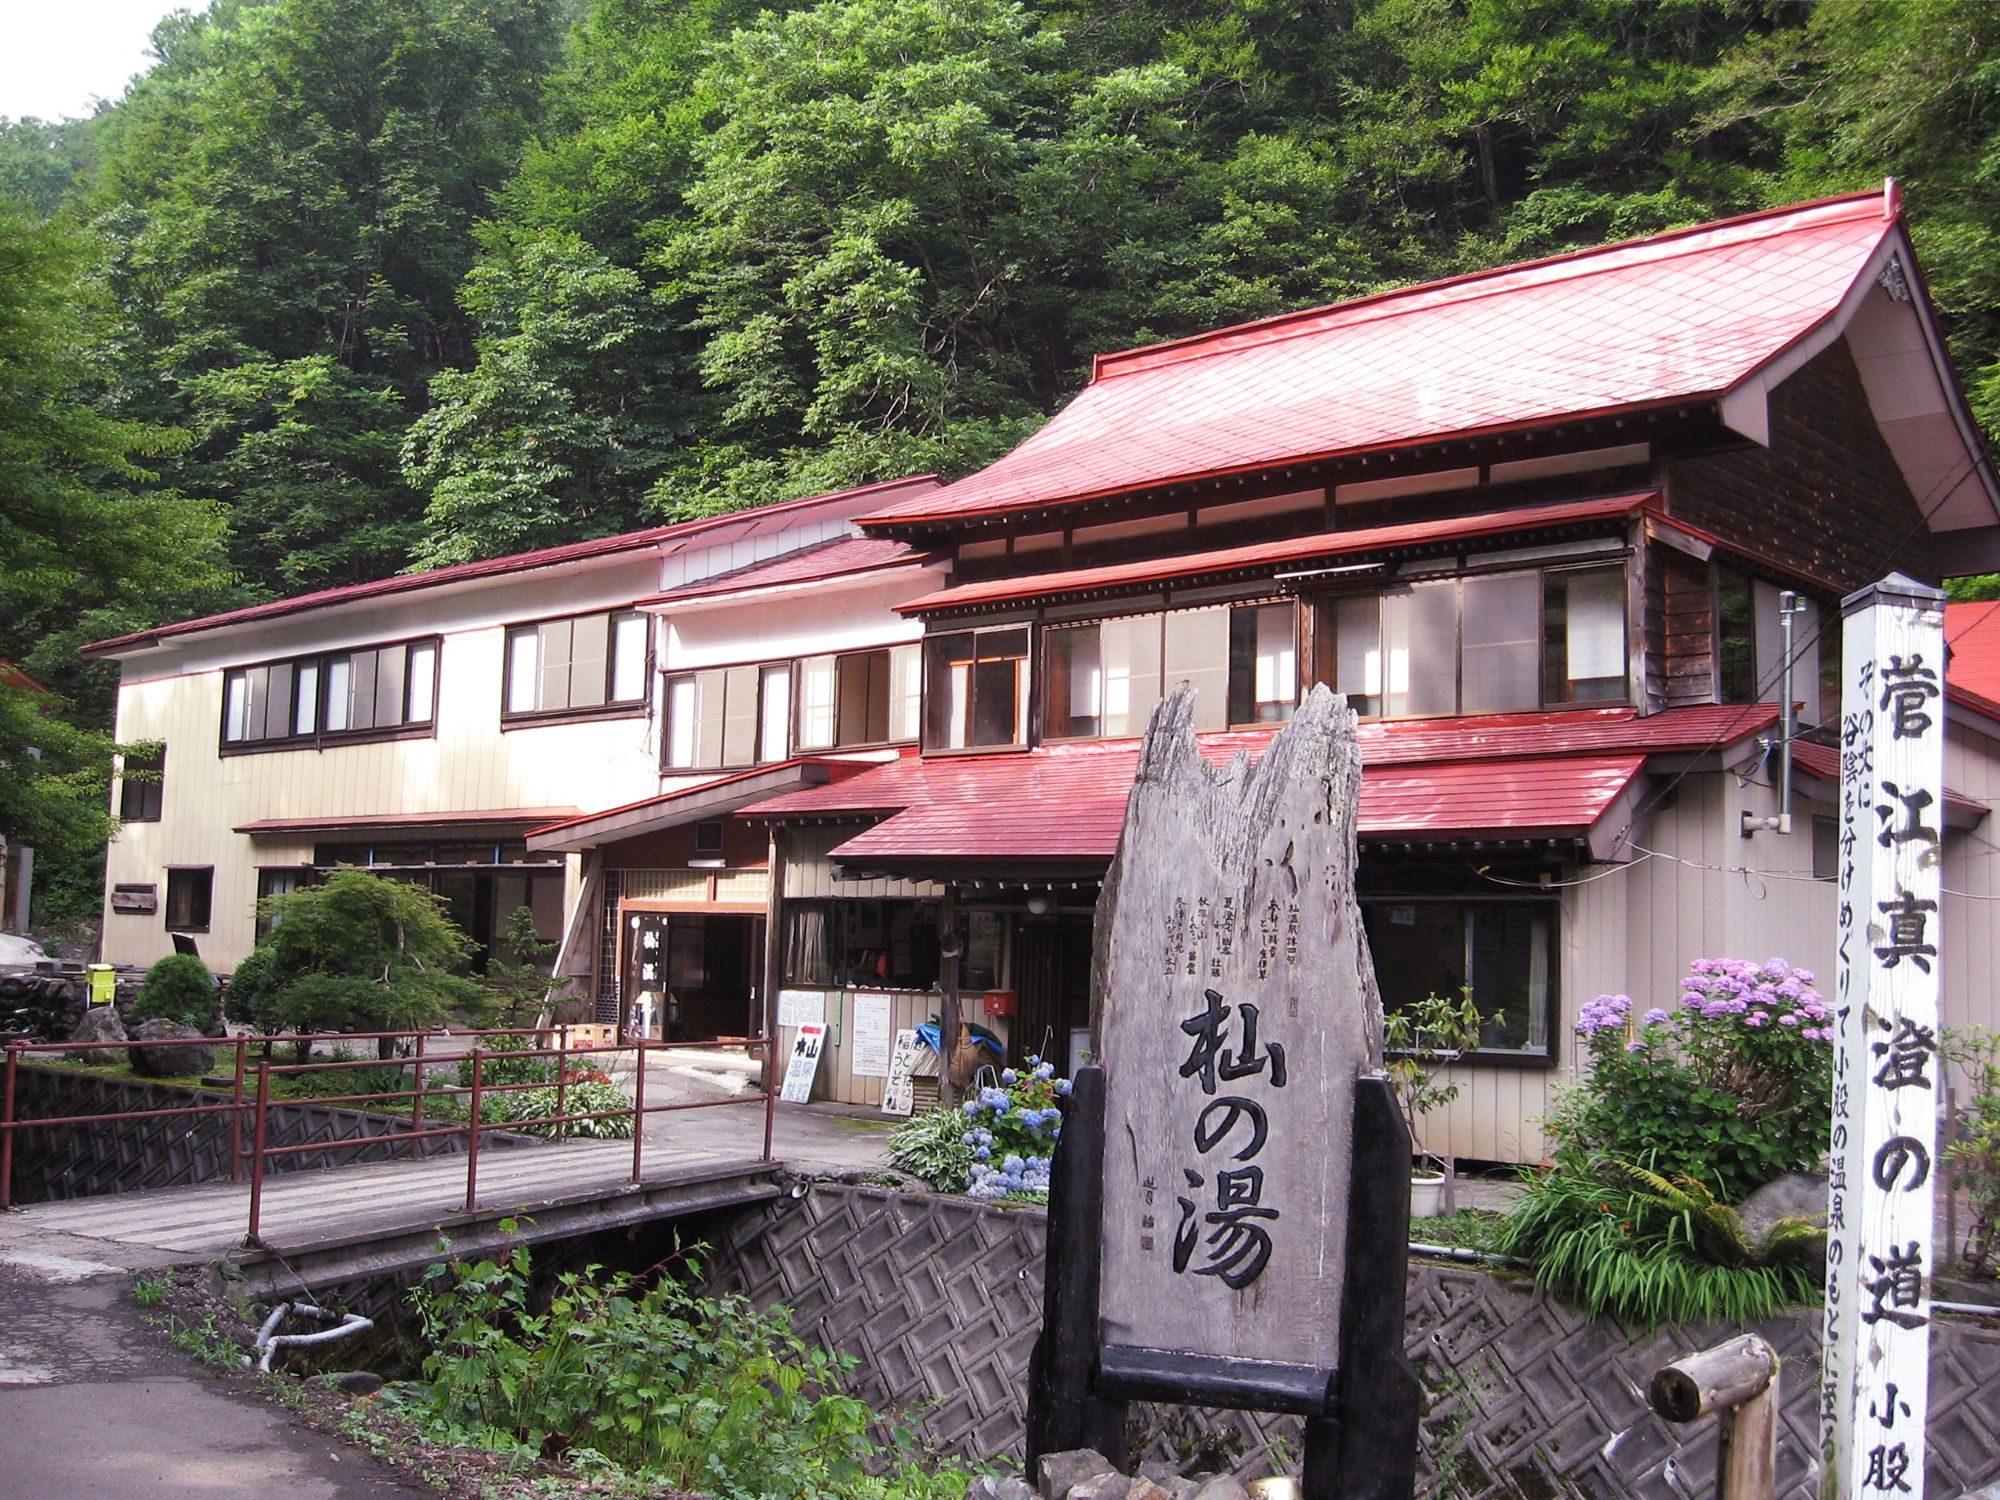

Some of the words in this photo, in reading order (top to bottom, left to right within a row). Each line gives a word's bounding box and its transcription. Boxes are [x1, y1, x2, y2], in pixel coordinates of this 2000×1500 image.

[1862, 653, 1940, 1330] 菅江真澄の道
[1863, 1382, 1912, 1493] 小股
